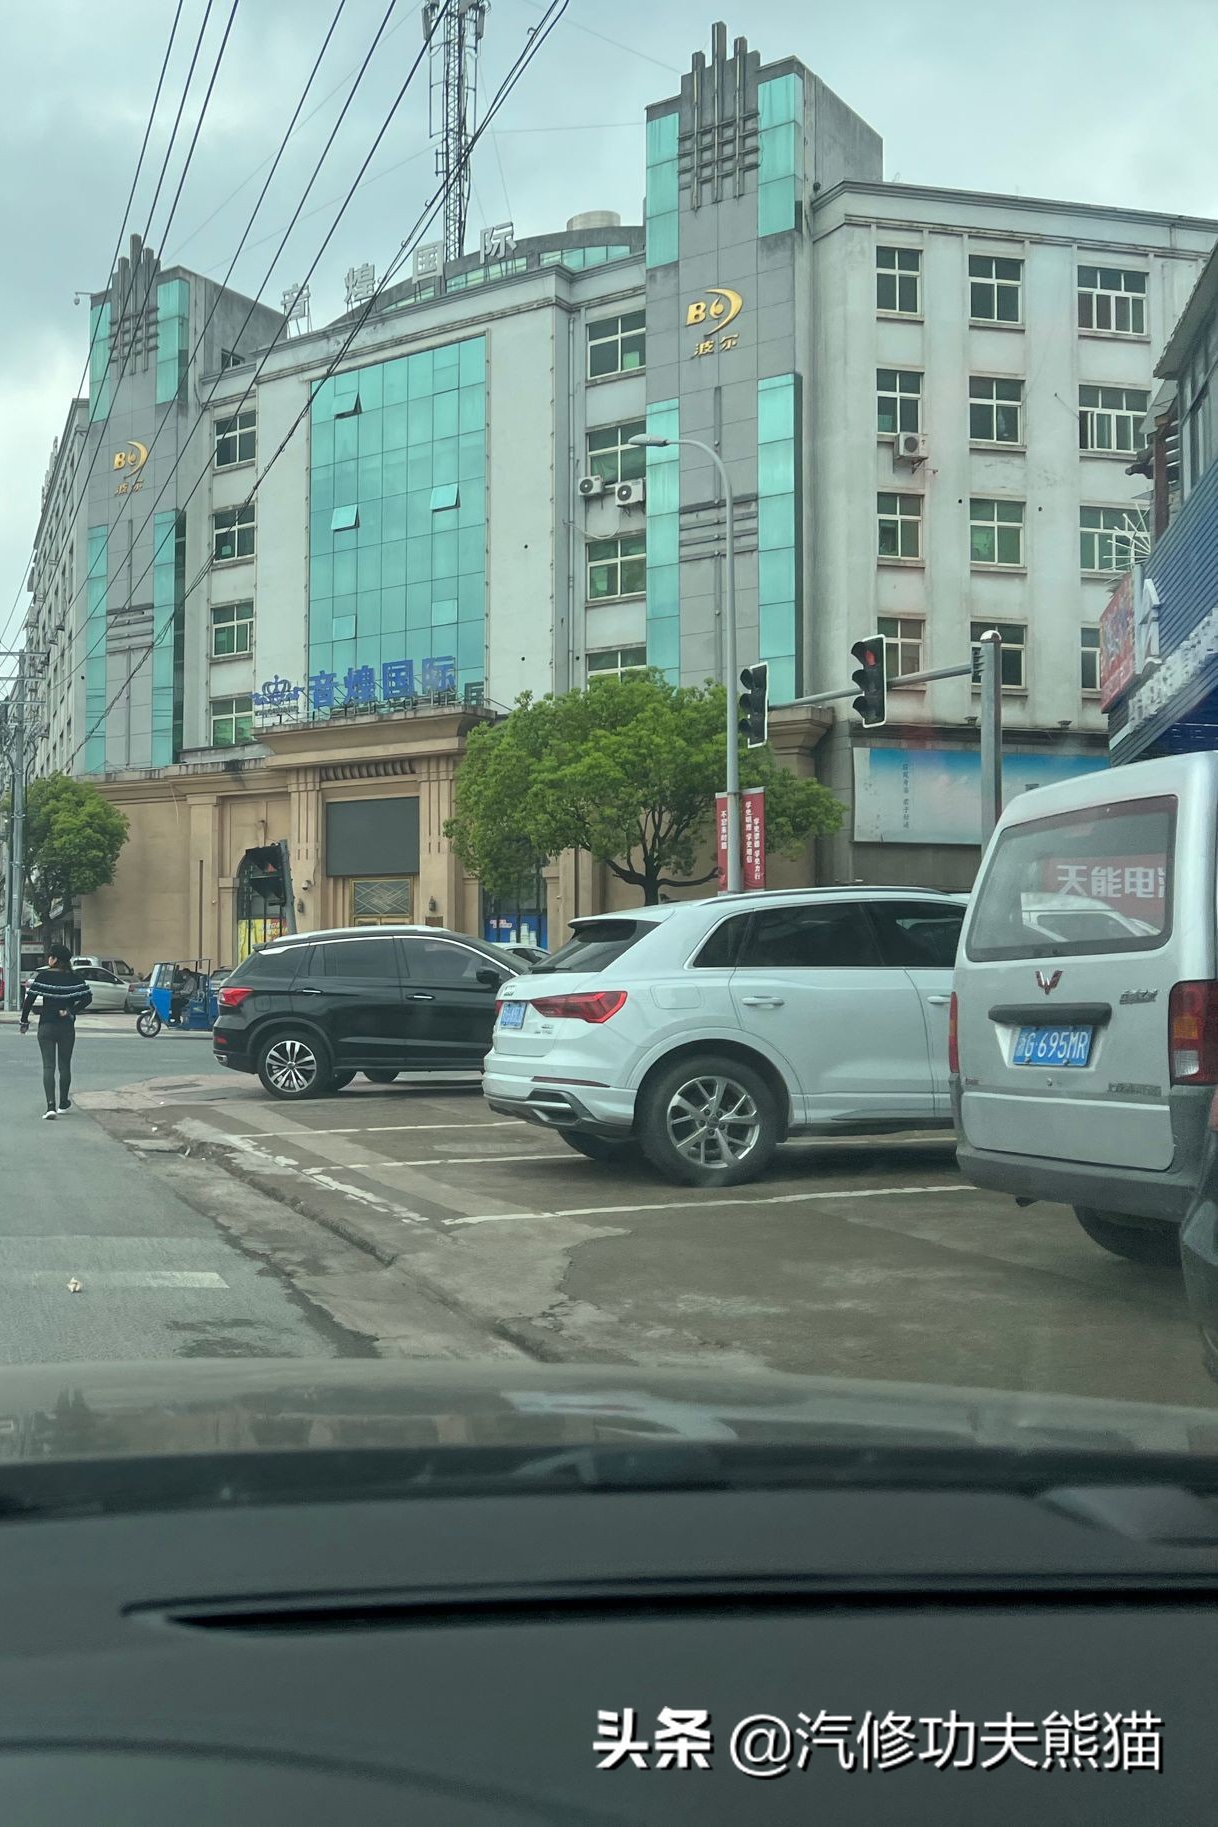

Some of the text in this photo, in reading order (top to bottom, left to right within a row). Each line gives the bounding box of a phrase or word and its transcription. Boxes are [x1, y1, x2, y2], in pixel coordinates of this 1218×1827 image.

[280, 221, 518, 321] 音煌国际
[309, 655, 456, 709] 音煌国际
